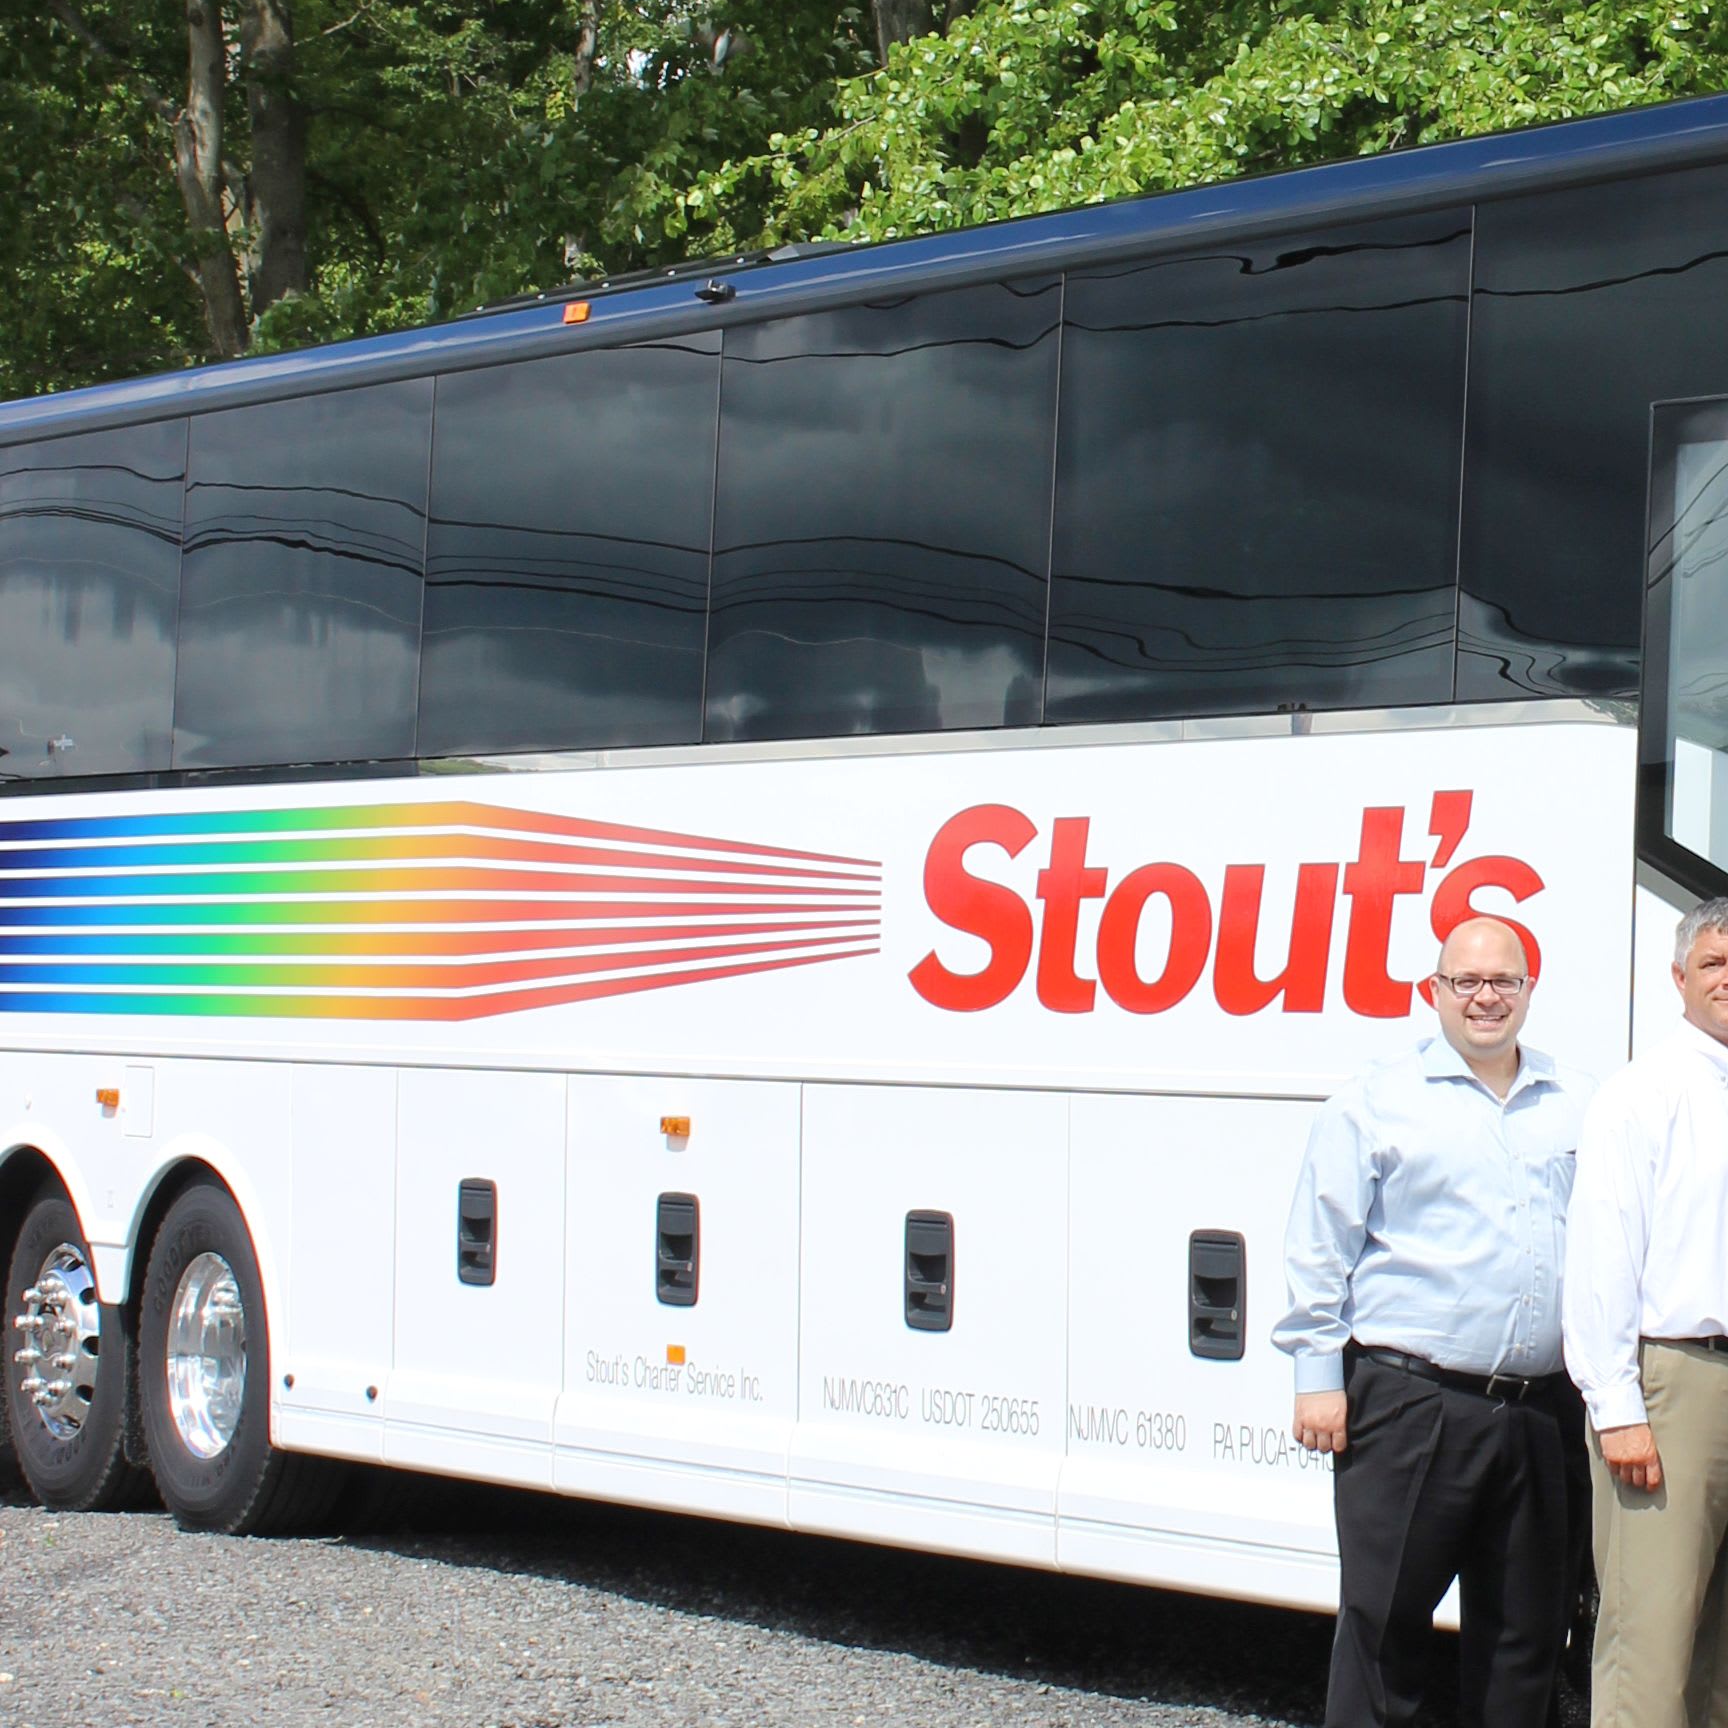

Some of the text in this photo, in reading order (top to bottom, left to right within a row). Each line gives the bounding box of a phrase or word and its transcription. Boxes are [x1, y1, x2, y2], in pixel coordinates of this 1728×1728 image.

[907, 789, 1546, 1019] Stout's
[586, 1349, 764, 1402] Stout's Charter Service Inc.
[921, 1387, 975, 1428] USDOT
[980, 1394, 1040, 1437] 250655
[1069, 1403, 1186, 1452] NJMVC 61380
[1212, 1422, 1235, 1461] PA
